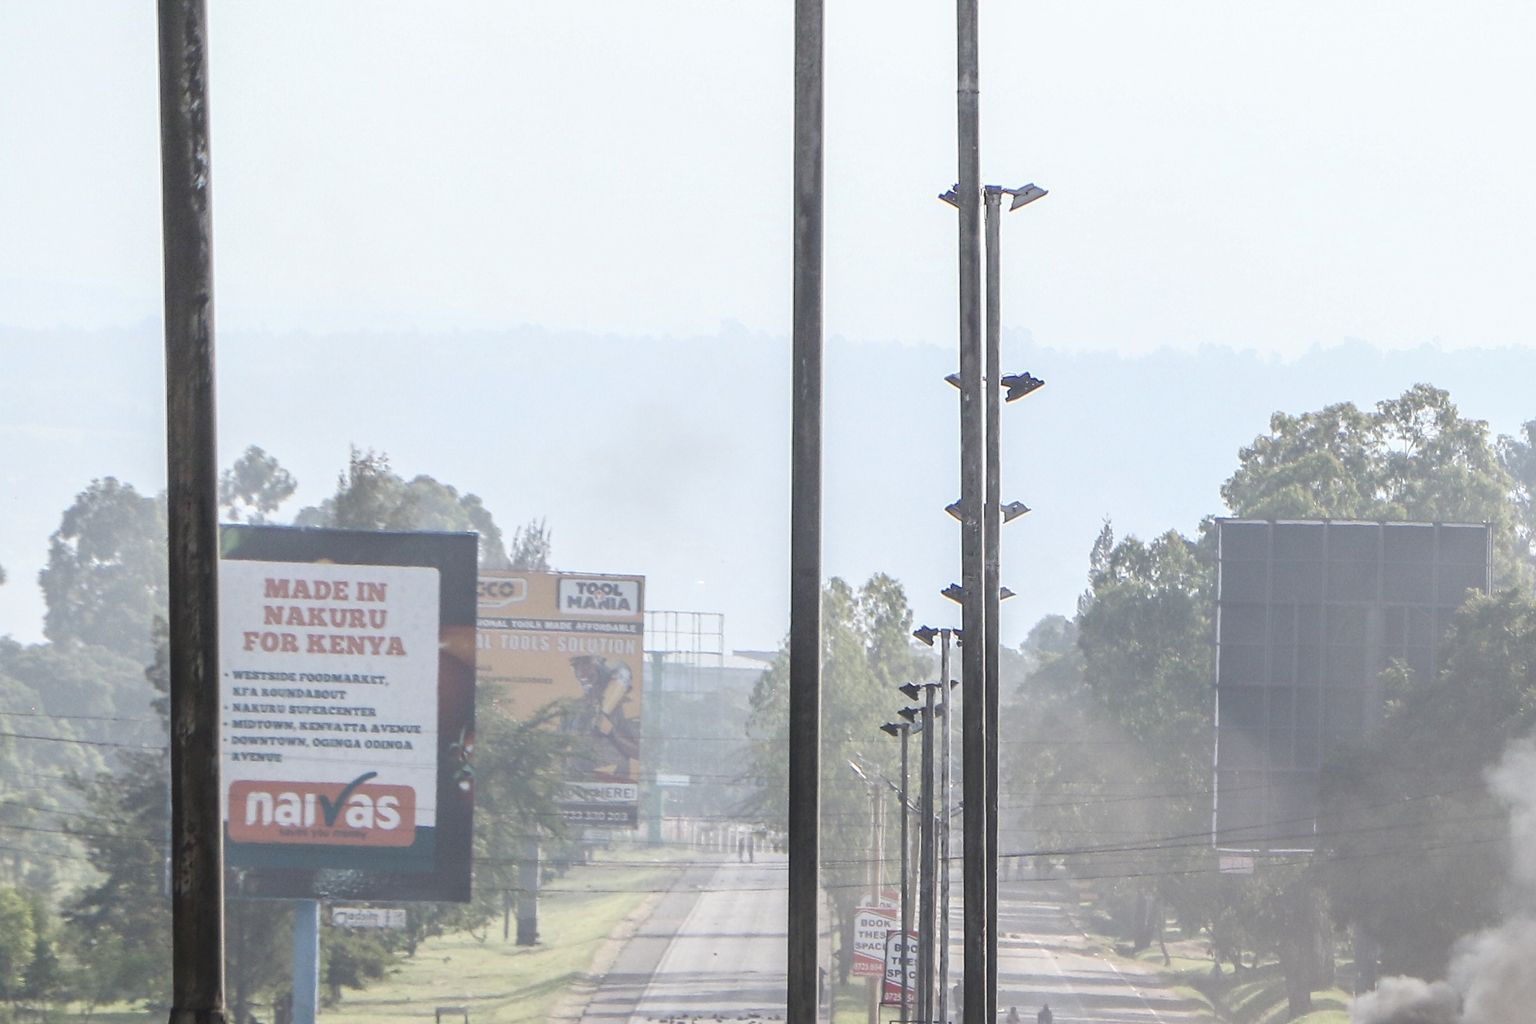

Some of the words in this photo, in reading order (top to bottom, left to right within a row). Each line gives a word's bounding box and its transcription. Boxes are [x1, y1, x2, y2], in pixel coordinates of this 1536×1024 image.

[264, 578, 349, 601] MADE
[356, 581, 388, 602] IN
[576, 582, 623, 596] TOOL
[567, 595, 631, 610] MANIA
[263, 605, 388, 629] NAKURU
[242, 631, 300, 653] FOR
[306, 633, 407, 656] KENYA
[500, 634, 550, 650] TOOLS
[557, 636, 636, 653] SOLUTION
[232, 670, 297, 682] WESTSIDE
[232, 703, 286, 714] NAKURU
[288, 705, 377, 717] SUPERCENTER
[371, 724, 422, 734] AVENUE
[232, 752, 283, 763] AVENUE
[245, 772, 401, 830] naivas
[861, 919, 891, 928] BOOK
[859, 931, 886, 939] THES
